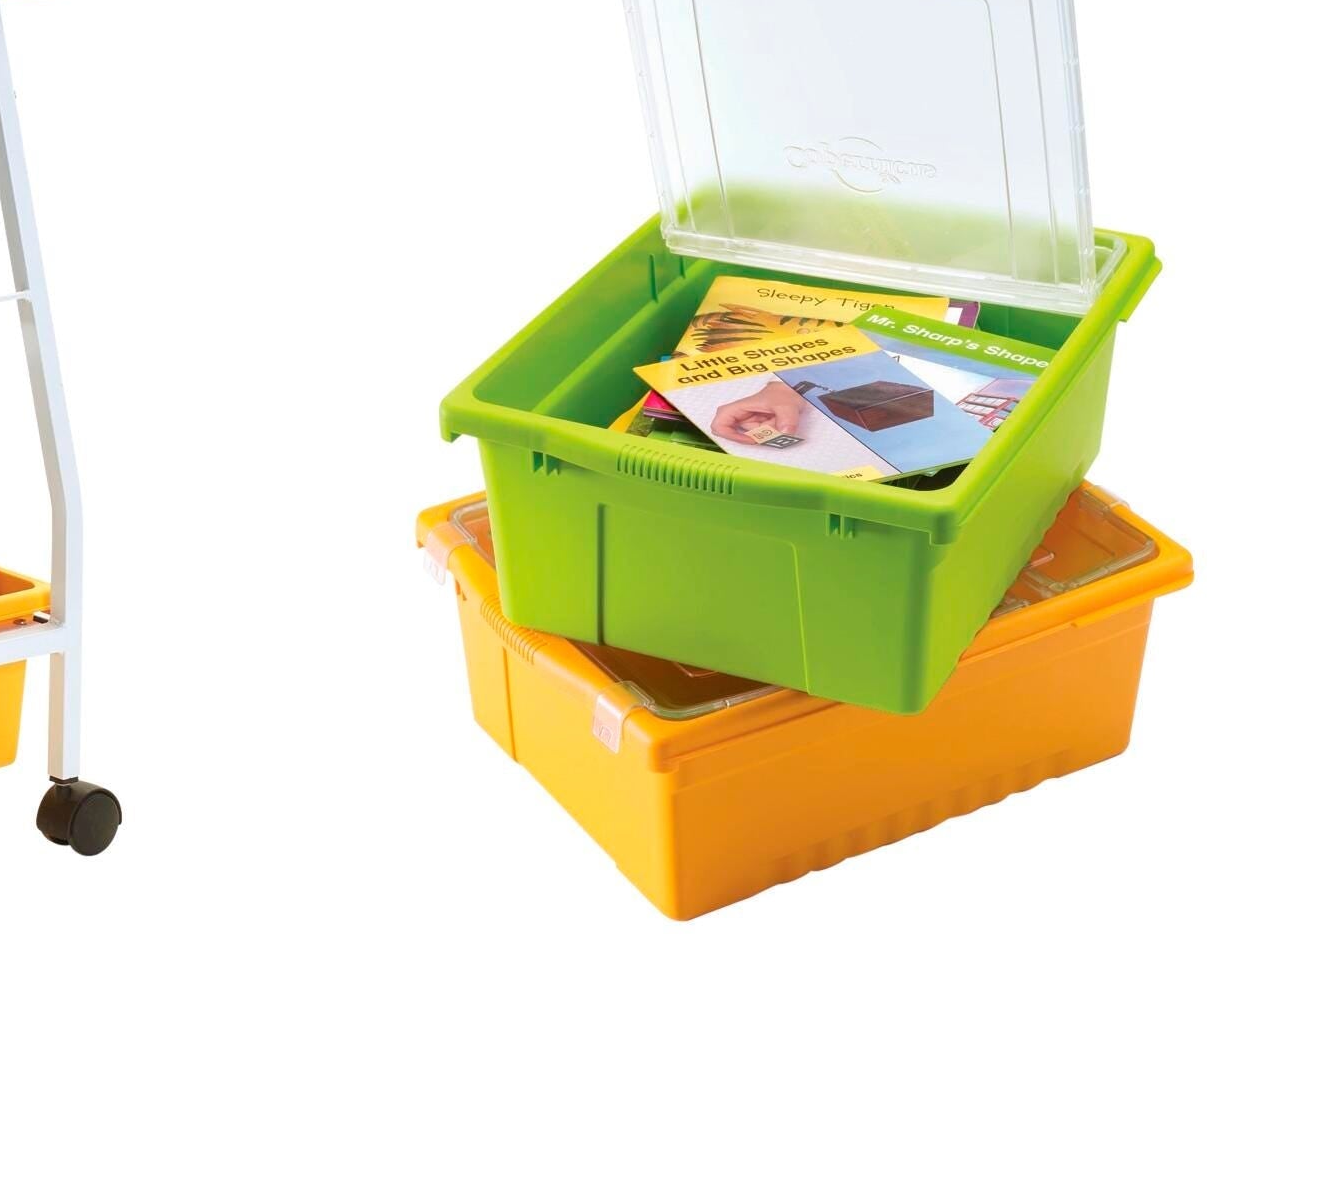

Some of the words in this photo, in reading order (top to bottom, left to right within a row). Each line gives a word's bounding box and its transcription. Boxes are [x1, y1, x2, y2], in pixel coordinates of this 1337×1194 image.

[757, 288, 827, 305] Sleepy
[866, 314, 896, 329] Mr.
[902, 324, 979, 351] Sharp's
[678, 370, 723, 384] and
[727, 362, 769, 377] Big
[774, 345, 856, 367] Shapes
[681, 354, 739, 372] Little
[743, 338, 829, 362] Shapes
